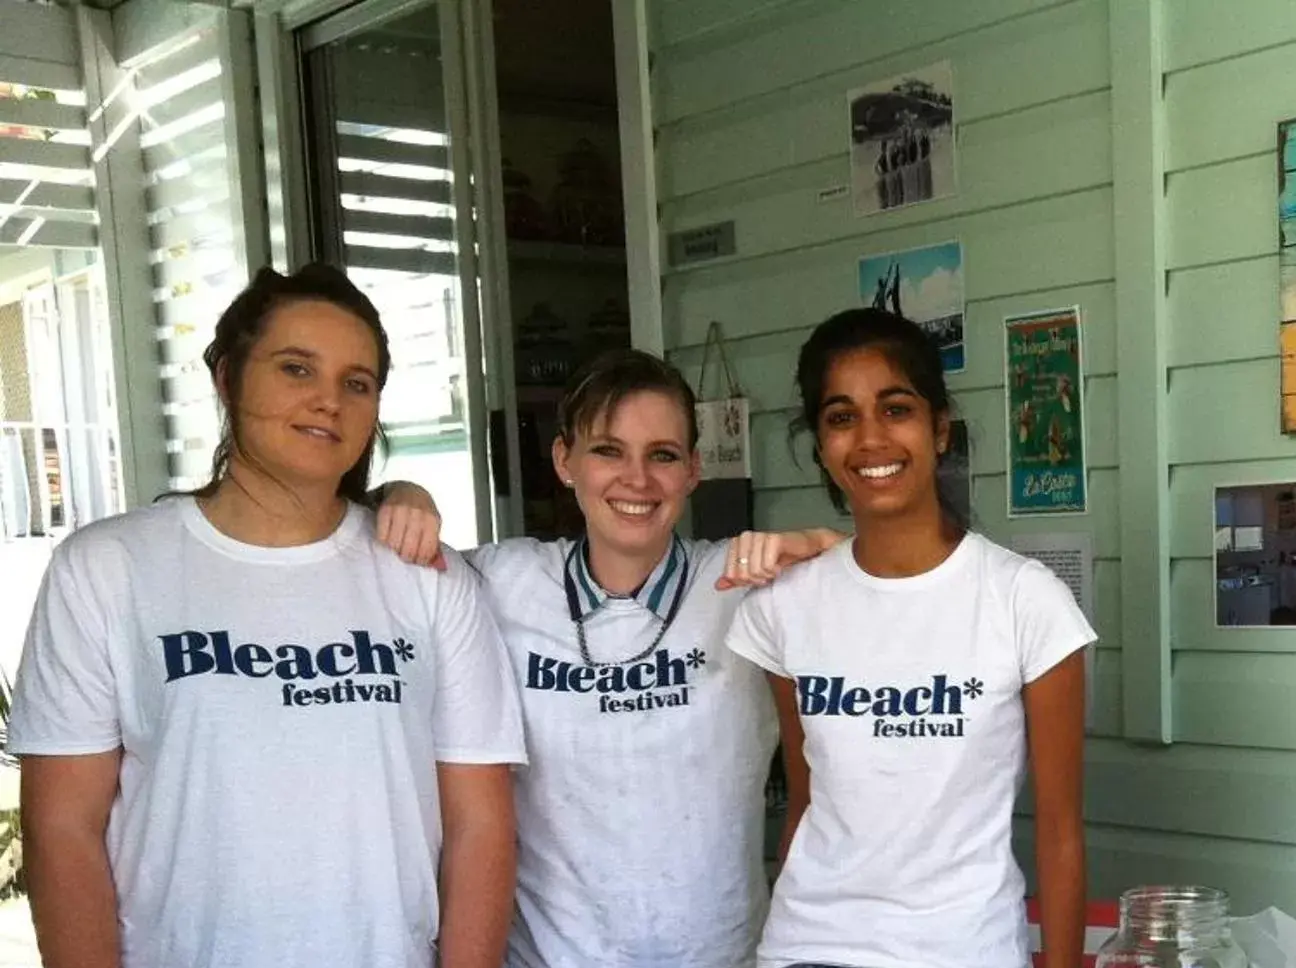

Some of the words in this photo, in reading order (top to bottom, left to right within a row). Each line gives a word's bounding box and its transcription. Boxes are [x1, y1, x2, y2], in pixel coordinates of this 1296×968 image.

[282, 679, 402, 706] festival
[599, 687, 690, 713] festival
[873, 718, 964, 737] festival
